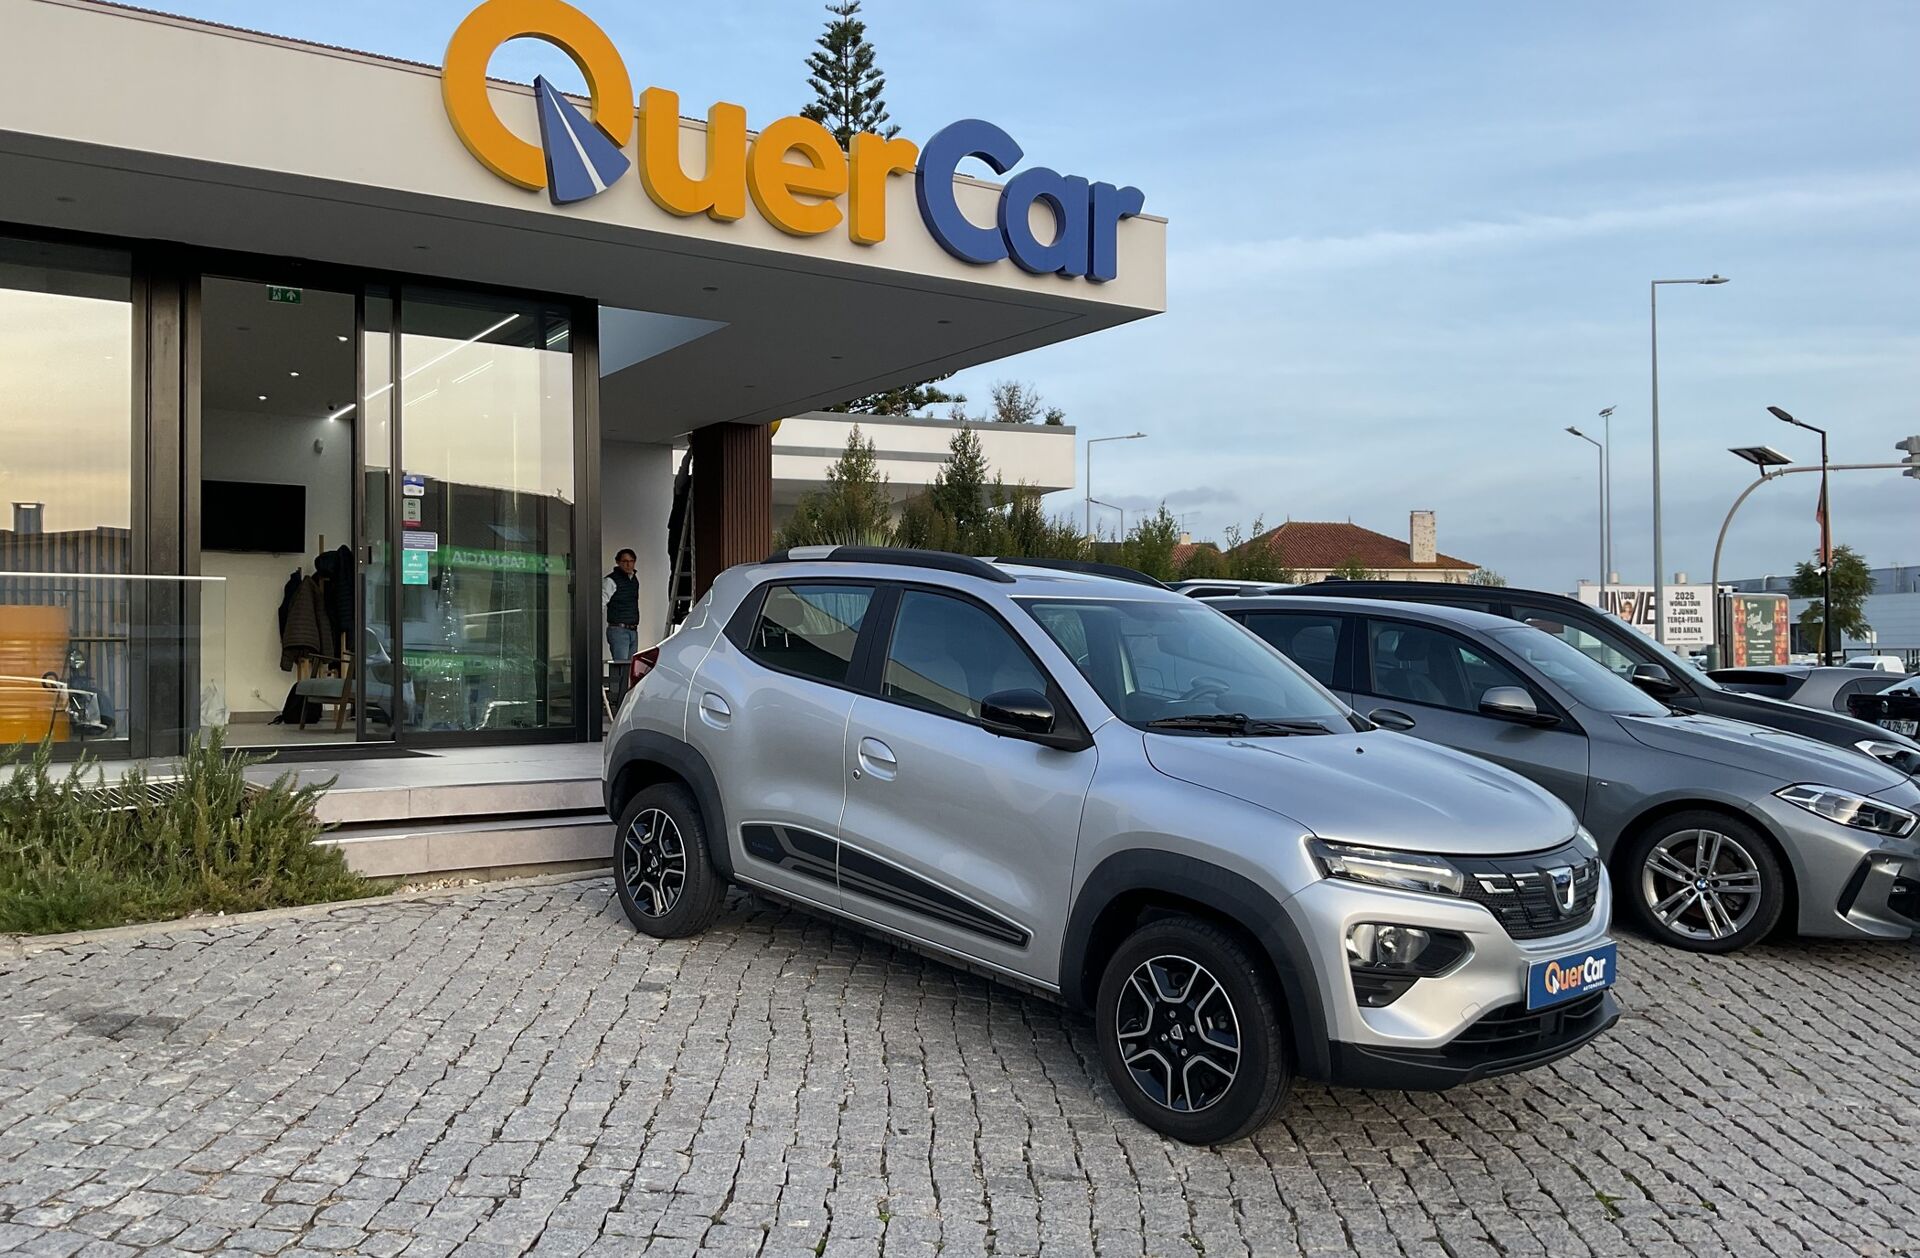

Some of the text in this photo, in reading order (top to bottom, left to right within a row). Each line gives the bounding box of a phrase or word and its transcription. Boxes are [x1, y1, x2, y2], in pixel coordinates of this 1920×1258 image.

[441, 0, 1145, 283] QuerCar
[1675, 592, 1695, 600] 2026
[1667, 617, 1703, 625] TERÇA-FEIRA
[1545, 956, 1606, 995] QuerCar
